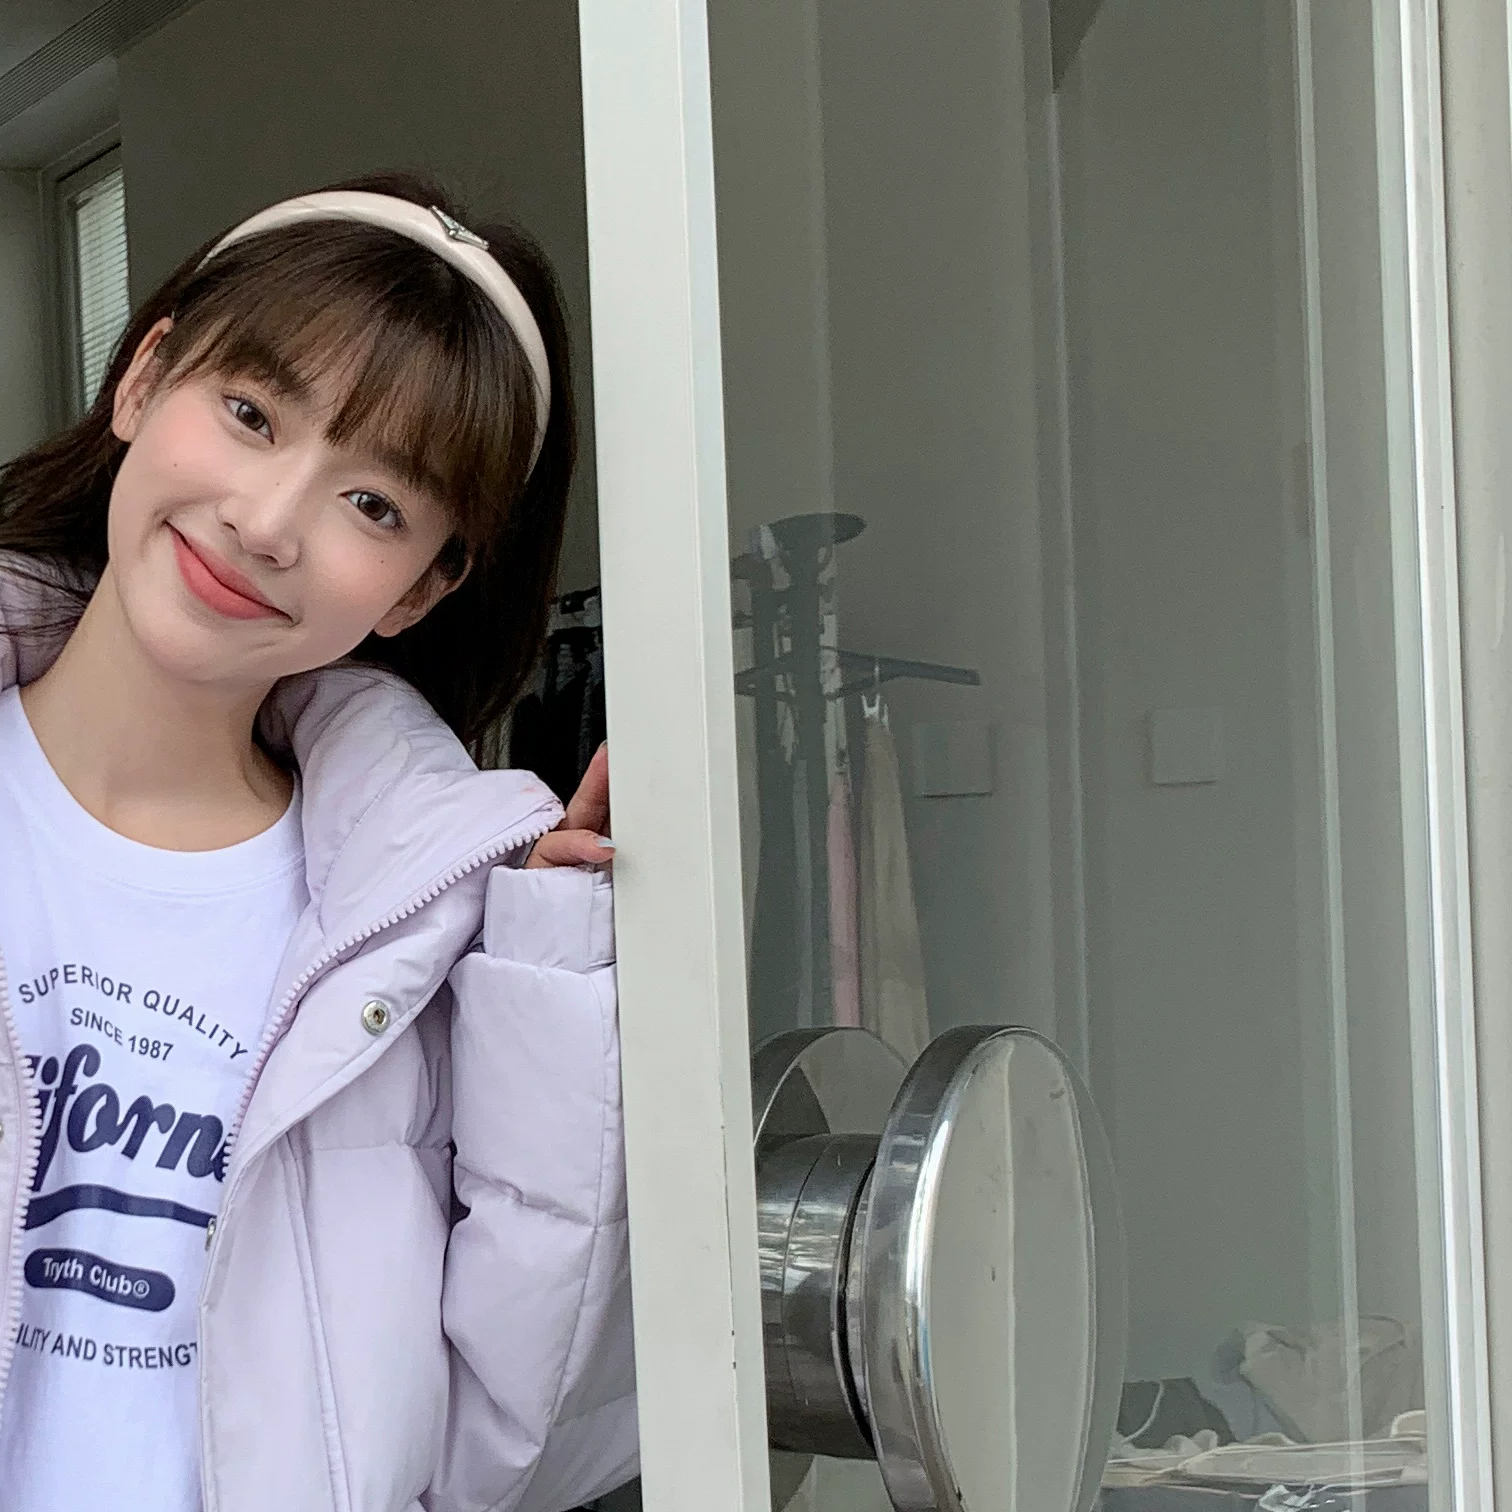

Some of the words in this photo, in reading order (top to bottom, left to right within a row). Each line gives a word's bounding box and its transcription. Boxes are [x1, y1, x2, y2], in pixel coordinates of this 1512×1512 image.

[18, 964, 133, 1004] SUPERIOR
[143, 989, 249, 1060] QUALITY
[70, 1007, 124, 1046] SINCE
[128, 1035, 174, 1061] 1987
[25, 1043, 232, 1192] iforn
[51, 1333, 97, 1361] AND
